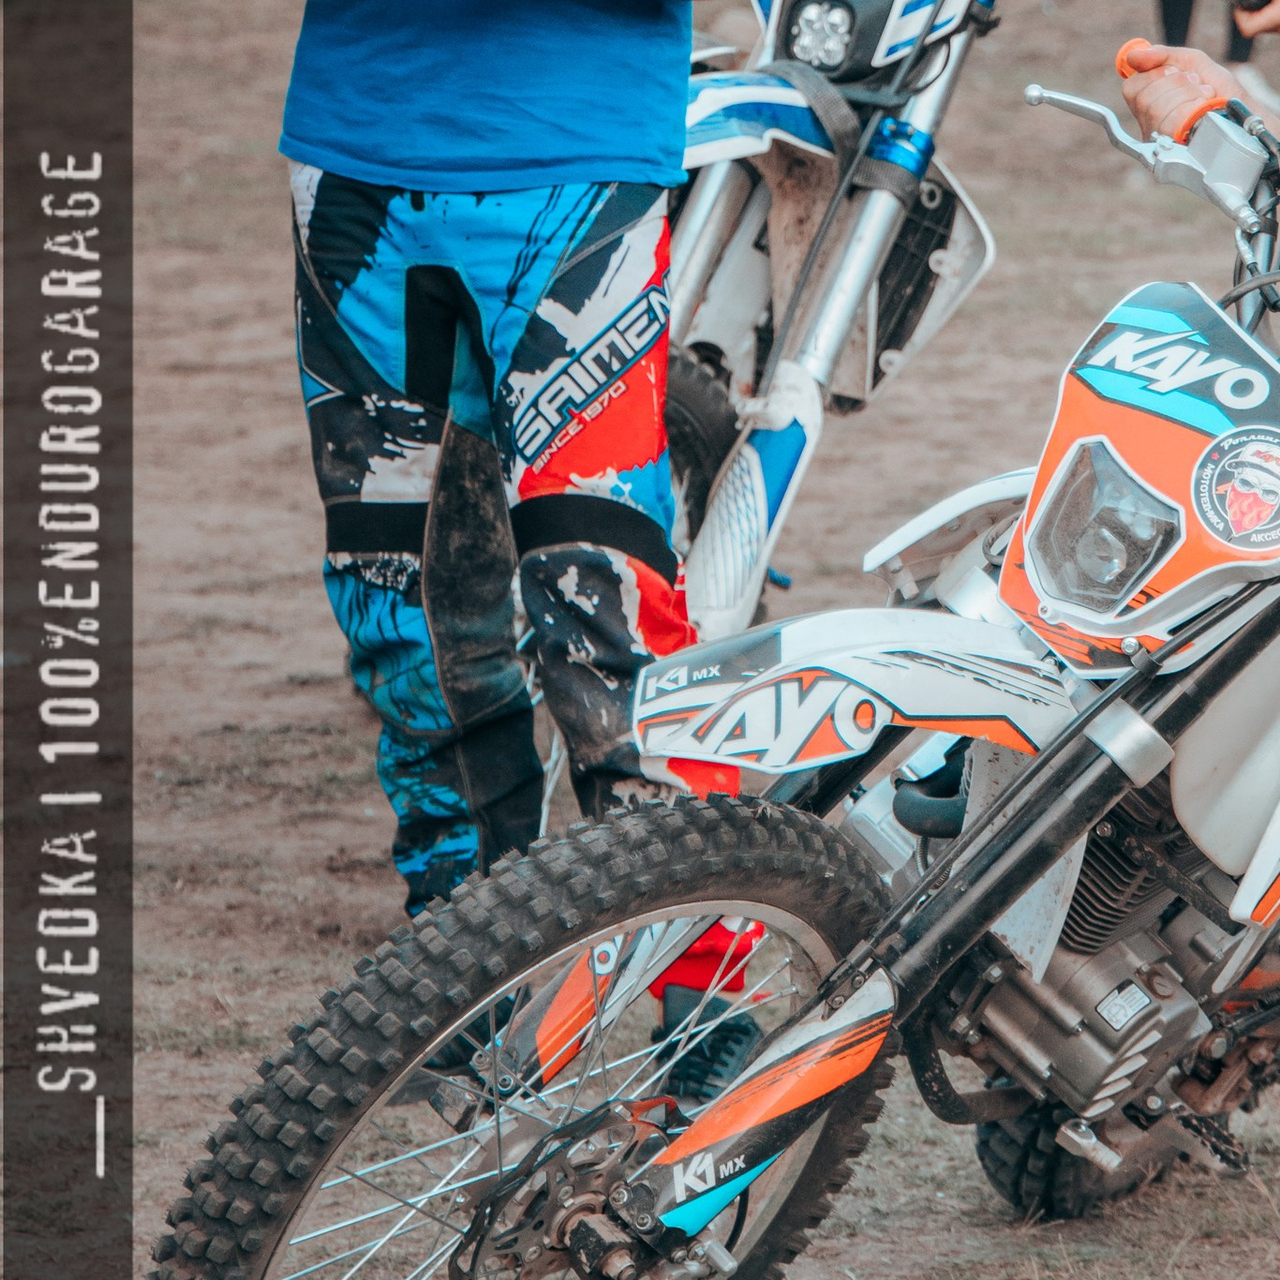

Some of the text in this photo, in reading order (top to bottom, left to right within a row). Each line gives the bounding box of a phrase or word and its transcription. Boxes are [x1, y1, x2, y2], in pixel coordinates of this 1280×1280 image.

[1088, 330, 1271, 410] KAYO
[532, 380, 628, 475] SINCE 1970
[1199, 463, 1226, 532] МОТОТЕХНИКА
[692, 665, 721, 682] MX
[719, 1154, 746, 1180] MX
